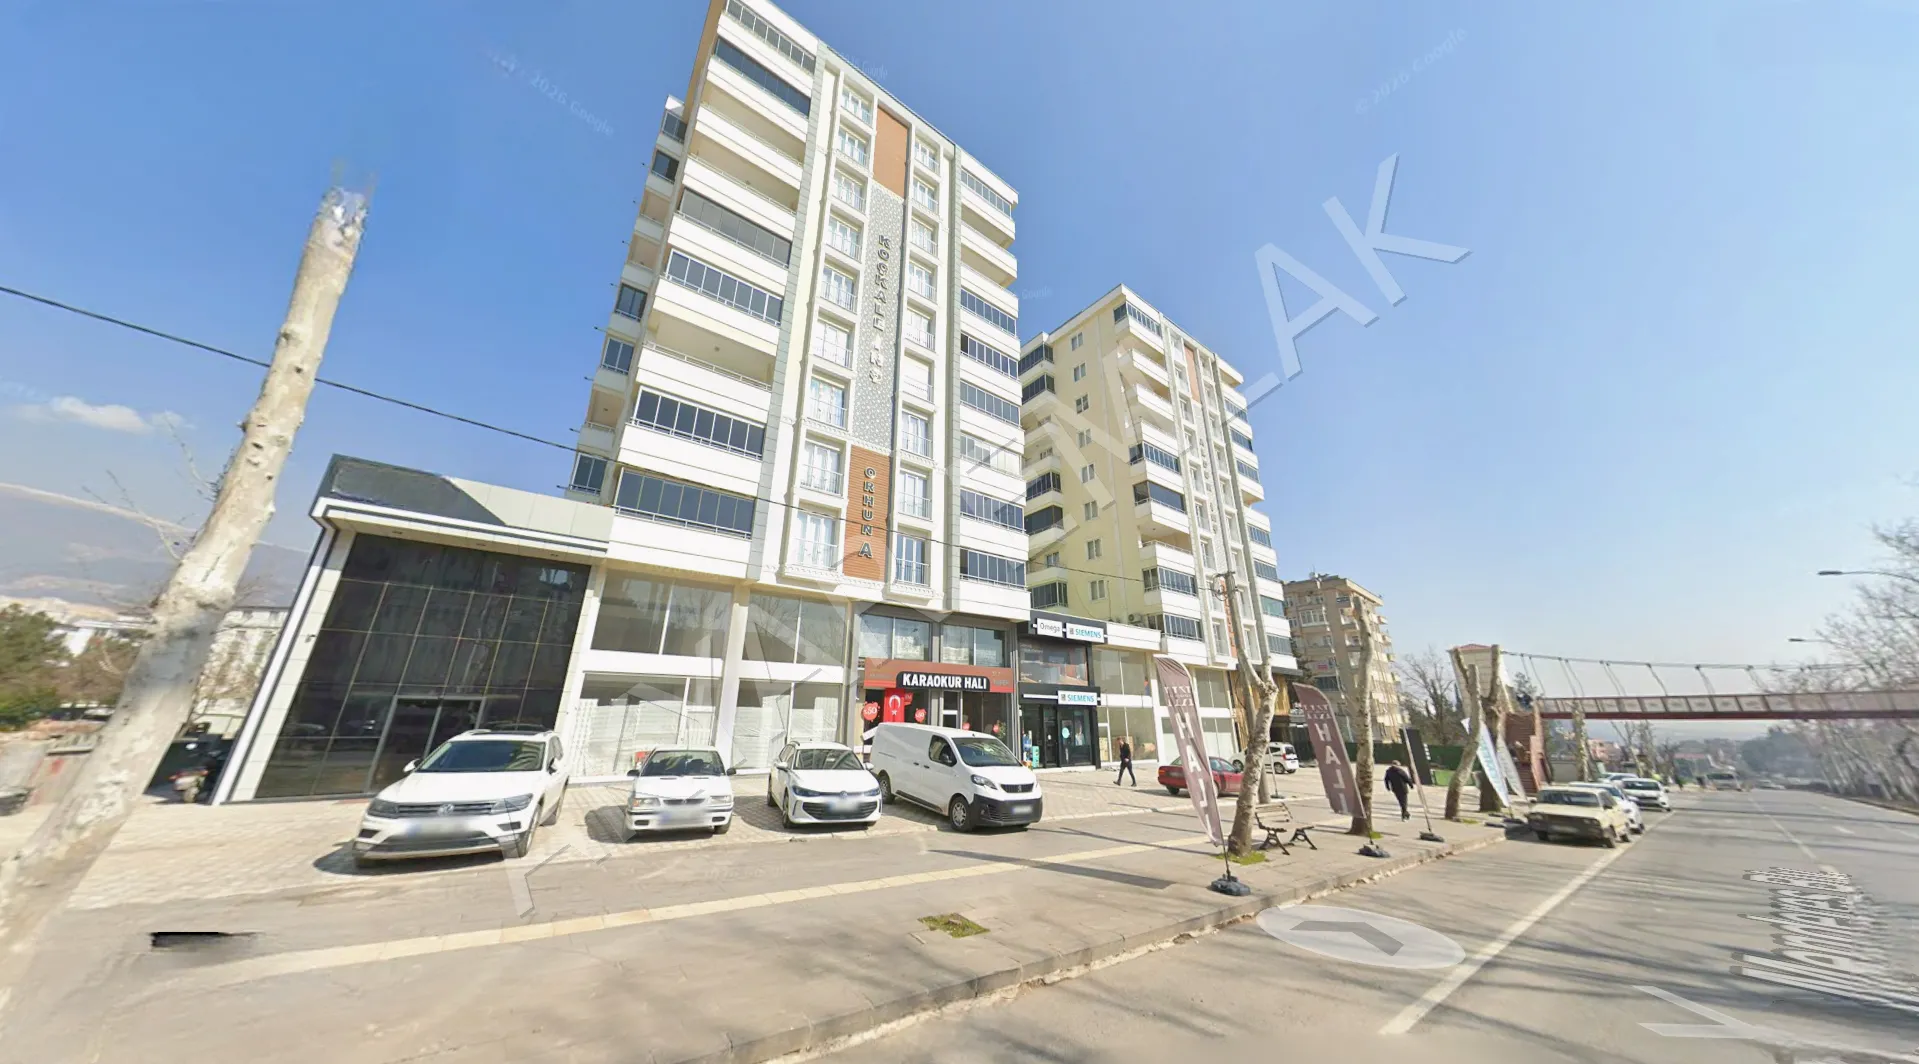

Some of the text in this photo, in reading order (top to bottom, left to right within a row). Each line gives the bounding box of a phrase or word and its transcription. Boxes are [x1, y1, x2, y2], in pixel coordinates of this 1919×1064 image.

[858, 466, 877, 559] ORHUN A
[1039, 622, 1061, 634] Omega
[1075, 628, 1102, 639] SIEMENS
[902, 672, 962, 689] KARAOKUR
[964, 676, 987, 690] HALI
[1067, 693, 1095, 703] SIEMENS
